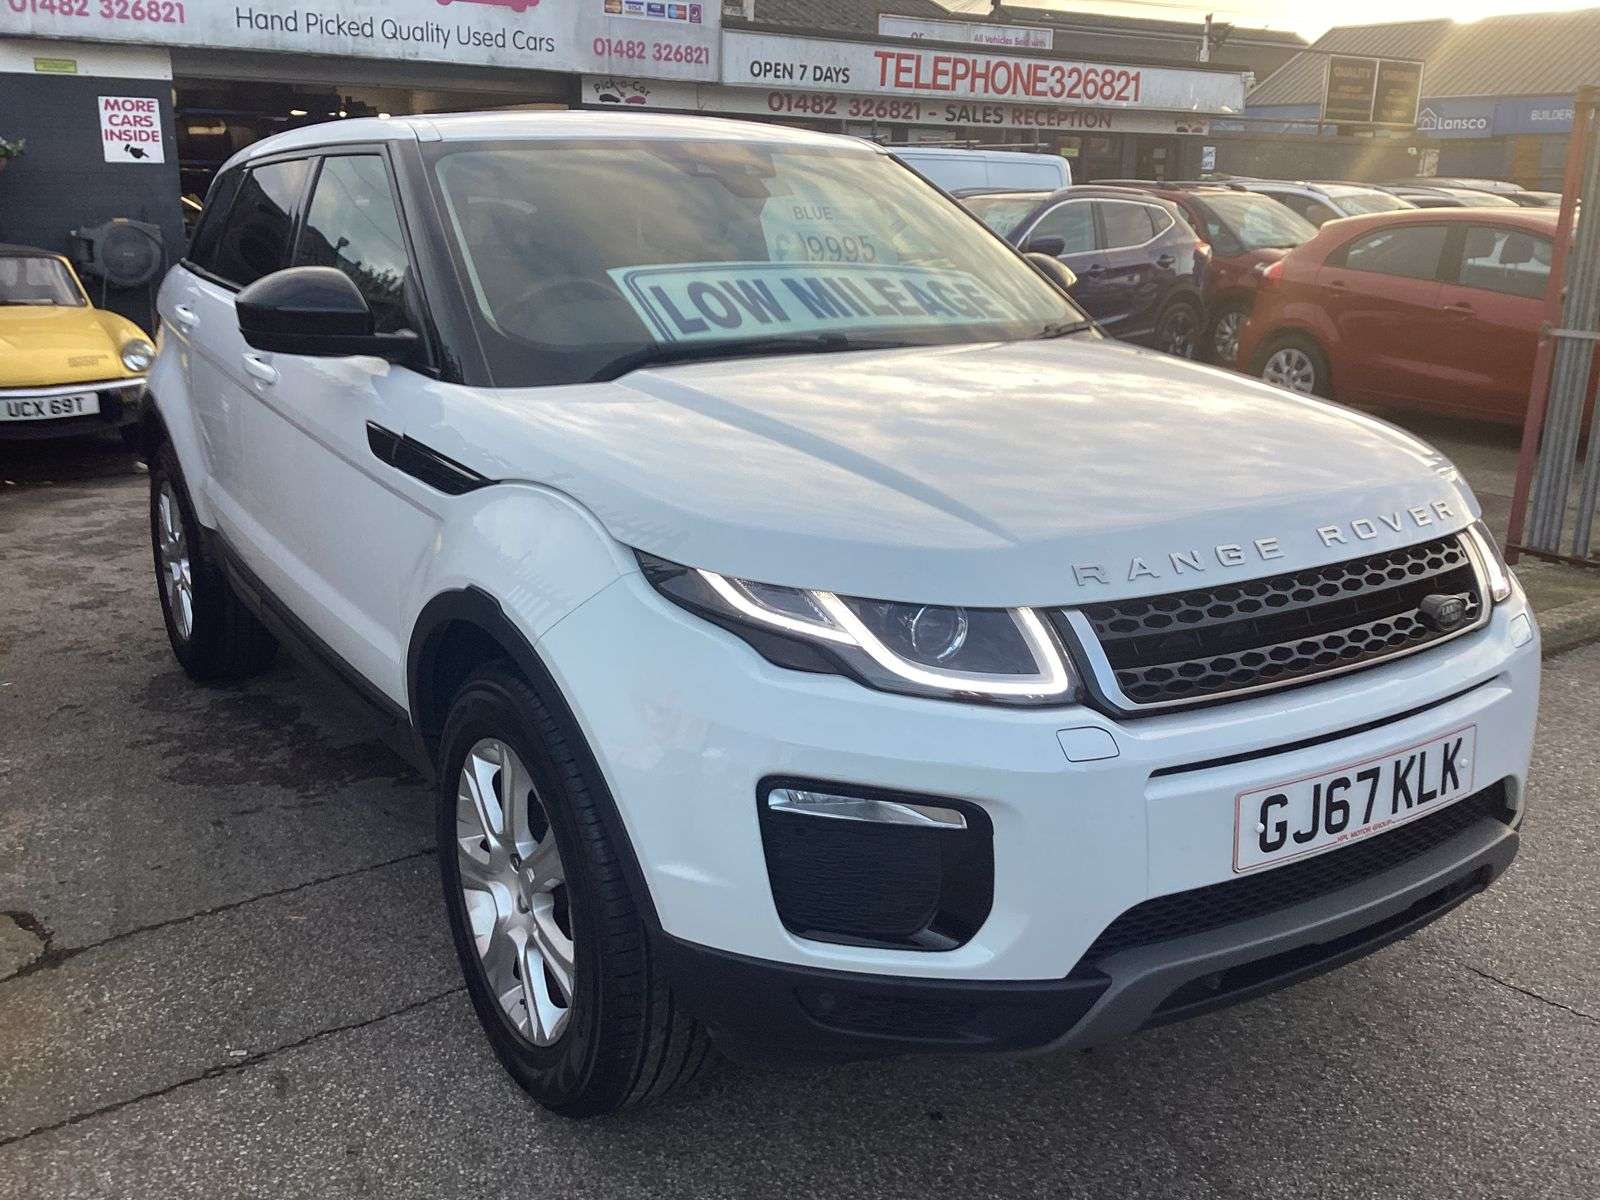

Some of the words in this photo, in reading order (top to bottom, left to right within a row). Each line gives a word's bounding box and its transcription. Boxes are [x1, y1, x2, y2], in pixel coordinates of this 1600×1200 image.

[99, 0, 185, 24] 326821
[235, 6, 298, 32] Hand
[305, 12, 374, 38] Picked
[381, 18, 450, 48] Quality
[457, 25, 507, 49] Used
[512, 30, 555, 53] Cars
[593, 37, 647, 59] 01482
[652, 42, 710, 65] 326821
[750, 60, 794, 79] OPEN
[799, 65, 808, 81] 7
[812, 65, 850, 84] DAYS
[104, 99, 156, 112] MORE
[767, 90, 837, 115] 01482
[848, 100, 921, 120] 326821
[945, 105, 1004, 124] SALES
[1011, 108, 1113, 129] RECEPTION
[108, 114, 154, 127] CARS
[1437, 117, 1487, 130] Lansco
[104, 129, 160, 142] INSIDE
[793, 206, 833, 221] BLUE
[649, 277, 791, 336] LOW
[781, 277, 1003, 320] MILEAGE
[7, 401, 47, 417] UCX
[51, 397, 84, 415] 69T
[1070, 536, 1286, 587] RANGE
[1316, 500, 1455, 547] ROVER
[1258, 766, 1381, 853] GJ67
[1391, 737, 1462, 815] KLK
